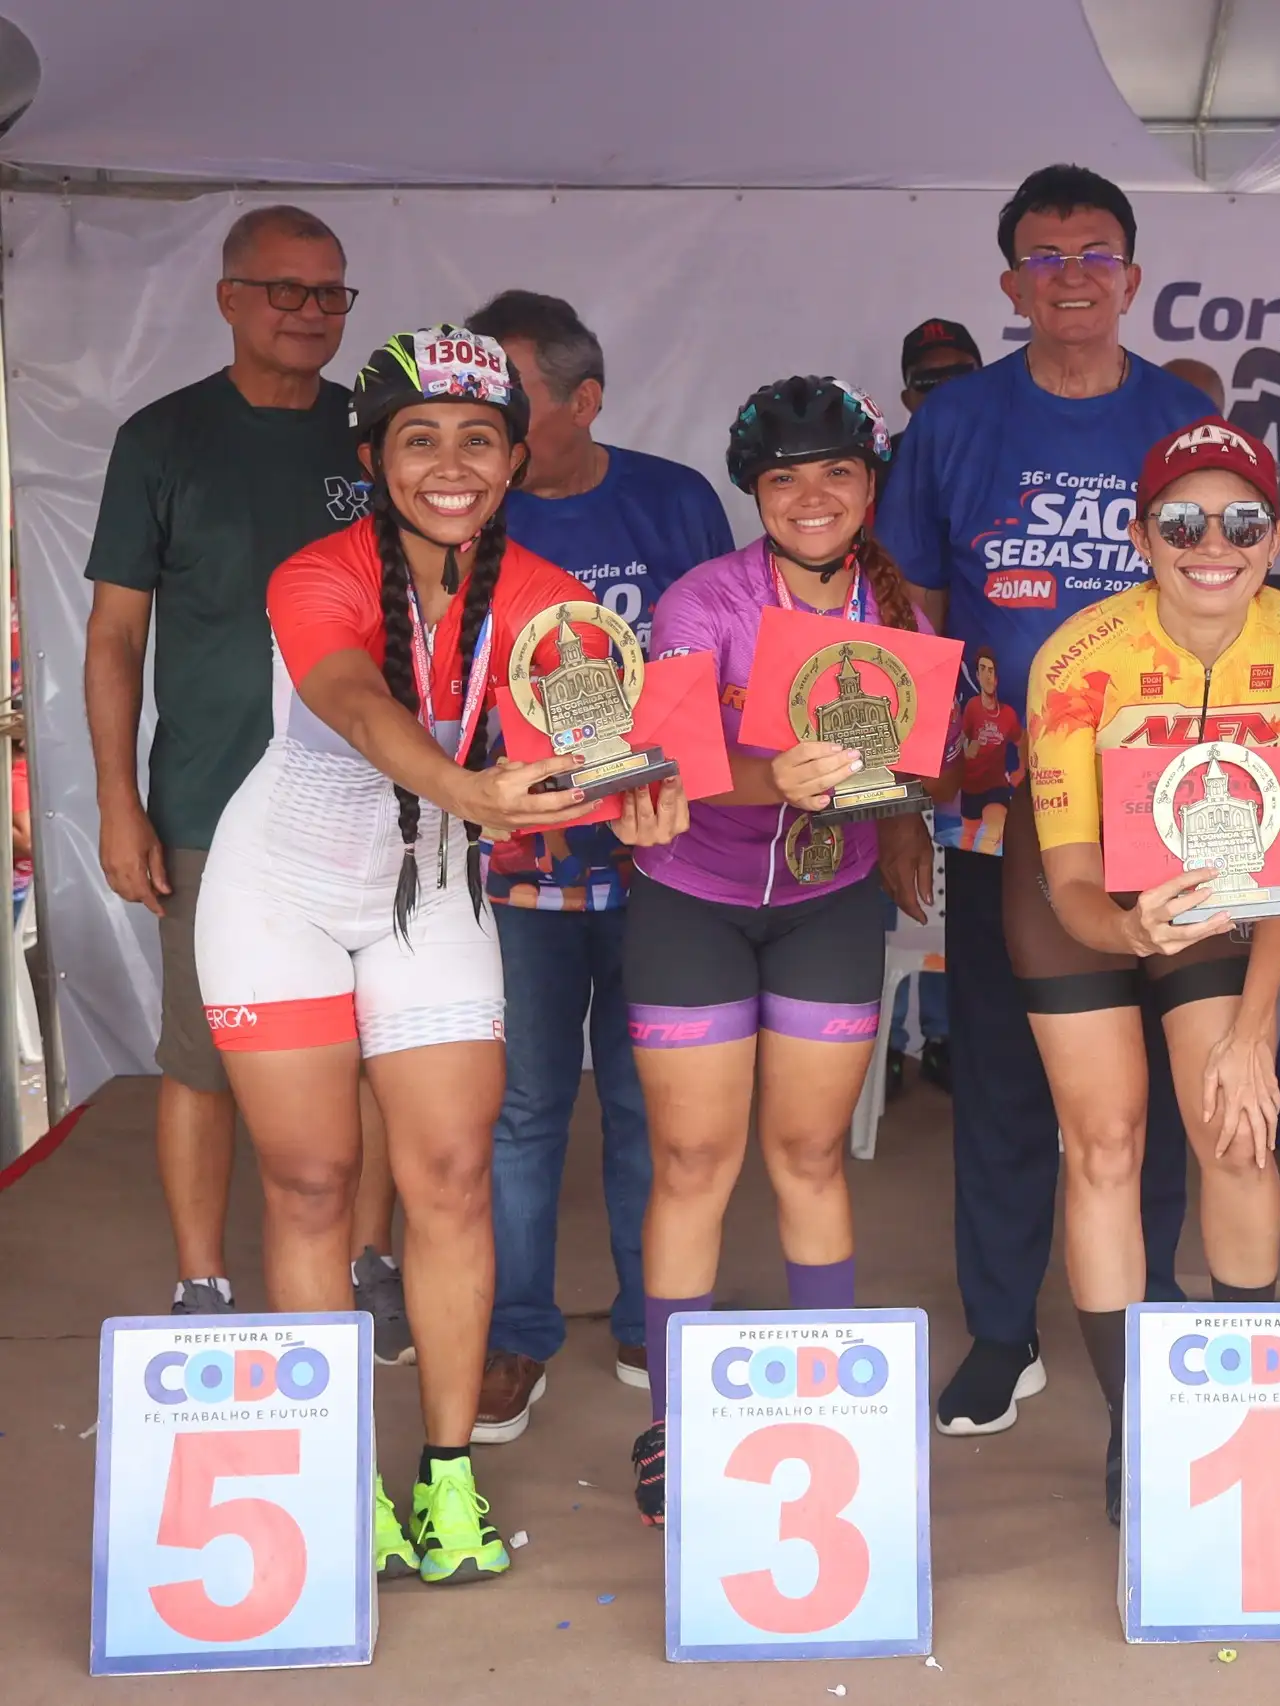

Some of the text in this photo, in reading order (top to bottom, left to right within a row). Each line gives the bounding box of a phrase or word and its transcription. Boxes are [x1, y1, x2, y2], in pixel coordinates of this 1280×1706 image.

[1019, 470, 1051, 486] 36ª
[1056, 472, 1127, 492] Corrida
[1026, 489, 1137, 541] SÃO
[625, 561, 648, 578] de
[1065, 576, 1102, 590] Codó
[1046, 617, 1124, 685] ANASTASIA
[174, 1332, 293, 1344] PREFEITURA DE
[739, 1329, 853, 1339] PREFEITURA DE
[144, 1340, 330, 1405] CODÓ
[711, 1338, 889, 1399] CODÓ
[1195, 1393, 1267, 1402] TRABALHO
[1273, 1393, 1279, 1402] E
[172, 1410, 250, 1422] TRABALHO
[257, 1410, 264, 1420] E
[270, 1408, 329, 1419] FUTURO
[739, 1406, 813, 1417] TRABALHO
[819, 1406, 826, 1415] E
[832, 1405, 888, 1415] FUTURO
[148, 1429, 308, 1643] 5
[719, 1422, 870, 1635] 3
